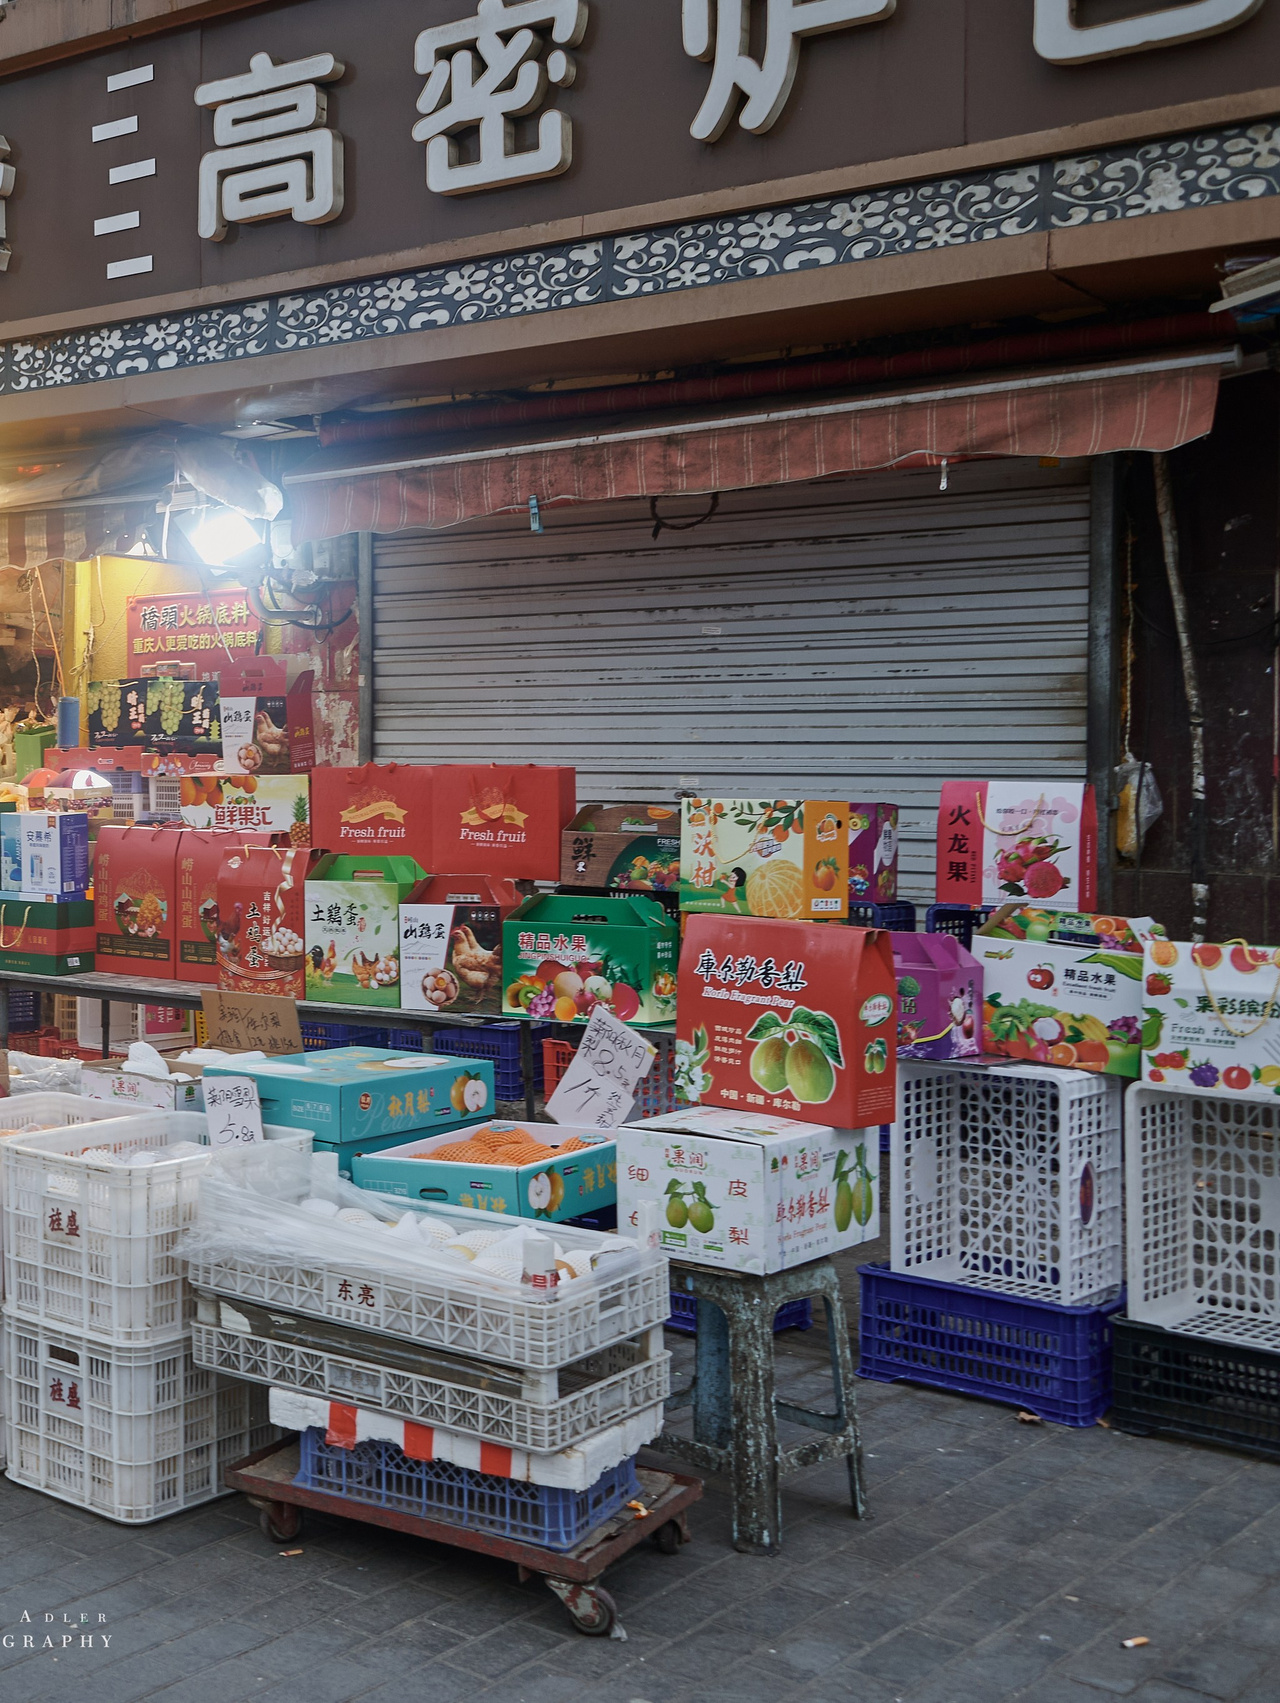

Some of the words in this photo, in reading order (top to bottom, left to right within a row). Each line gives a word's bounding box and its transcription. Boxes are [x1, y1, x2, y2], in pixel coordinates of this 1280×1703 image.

[133, 630, 258, 654] 重庆人更爱吃的火锅底料
[215, 805, 273, 826] 鲜果汇
[340, 826, 375, 838] Fresh
[377, 826, 406, 838] fruit
[459, 828, 495, 841] Fresh
[495, 831, 526, 843] fruit
[947, 805, 971, 882] 火龙果
[690, 829, 716, 889] 沃柑
[98, 853, 110, 922] 崂山山鸡蛋
[181, 857, 194, 929] 崂山山鸡蛋
[518, 931, 587, 951] 精品水果
[1064, 968, 1116, 986] 精品水果
[1171, 1023, 1206, 1036] Fresh
[292, 1104, 305, 1113] SIZE
[387, 1088, 431, 1118] 秋月梨
[671, 1150, 705, 1168] 果润
[628, 1164, 650, 1182] 细
[728, 1179, 748, 1198] 皮
[728, 1227, 750, 1246] 梨
[337, 1278, 375, 1308] 东亮
